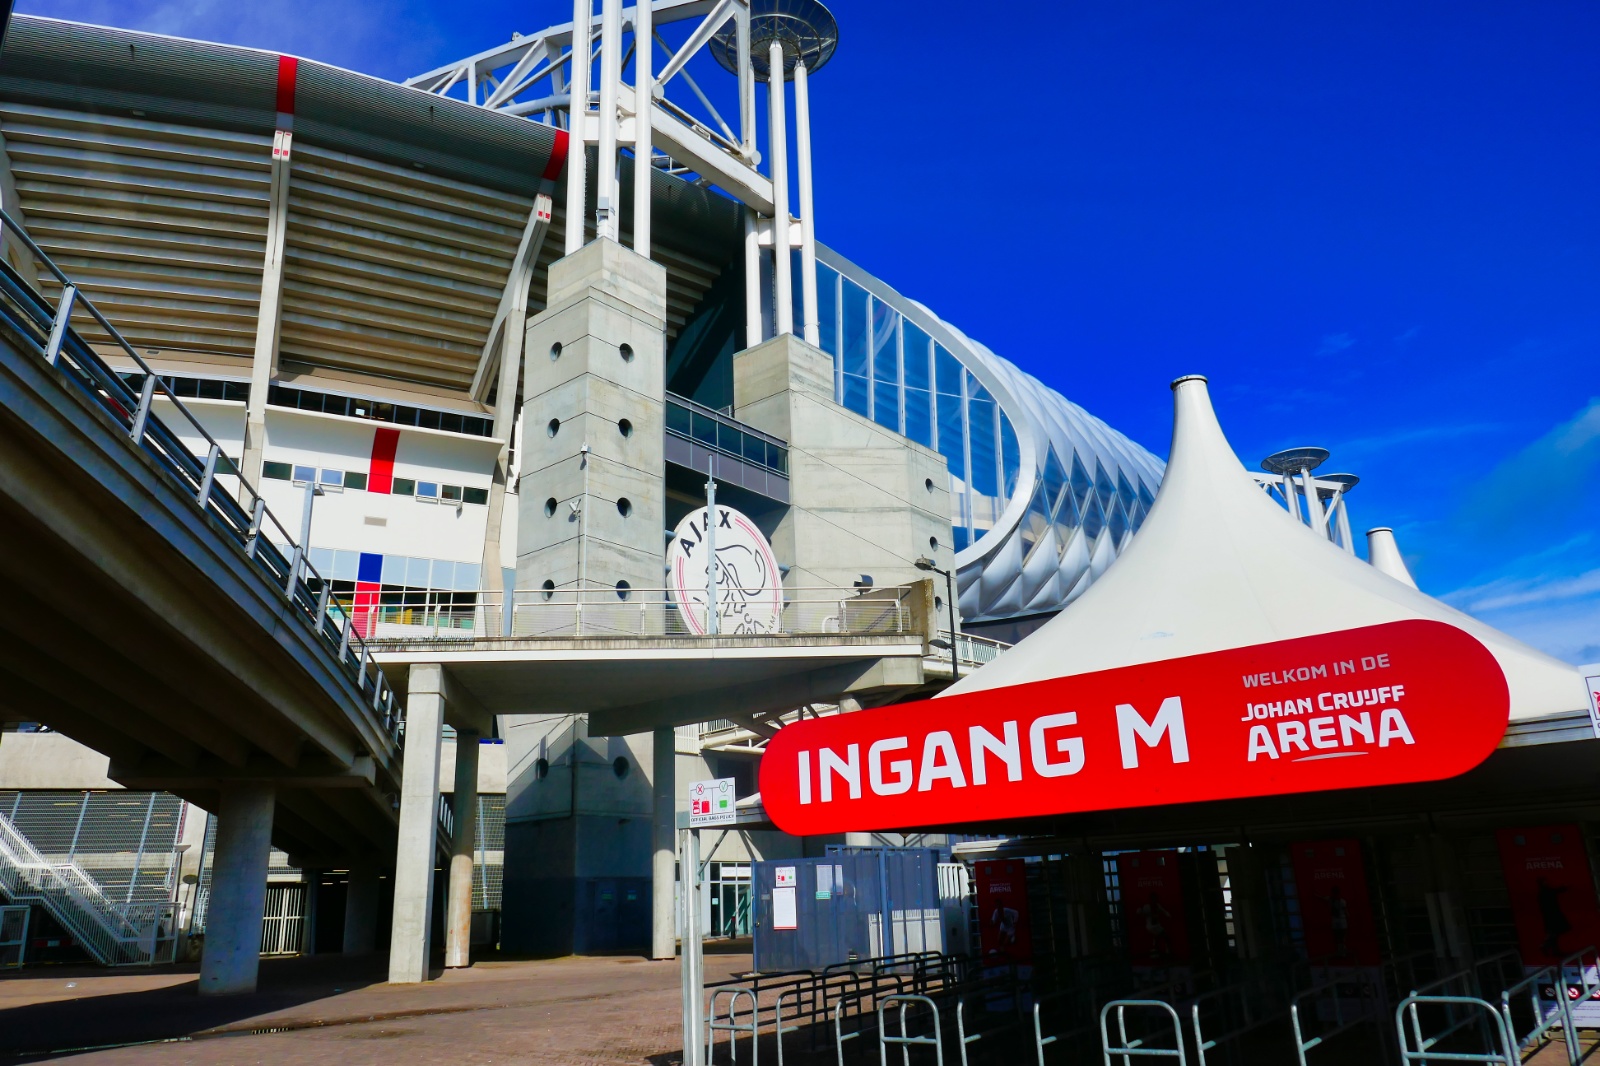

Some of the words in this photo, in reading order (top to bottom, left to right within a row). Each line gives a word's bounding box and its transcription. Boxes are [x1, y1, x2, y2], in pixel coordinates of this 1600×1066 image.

[1242, 664, 1328, 688] WELKOM
[1333, 660, 1356, 676] IN
[1361, 653, 1391, 671] DE
[1240, 697, 1314, 722] JOHAN
[797, 711, 1086, 805] INGANG
[1114, 695, 1190, 770] M
[1247, 708, 1416, 762] ARENA
